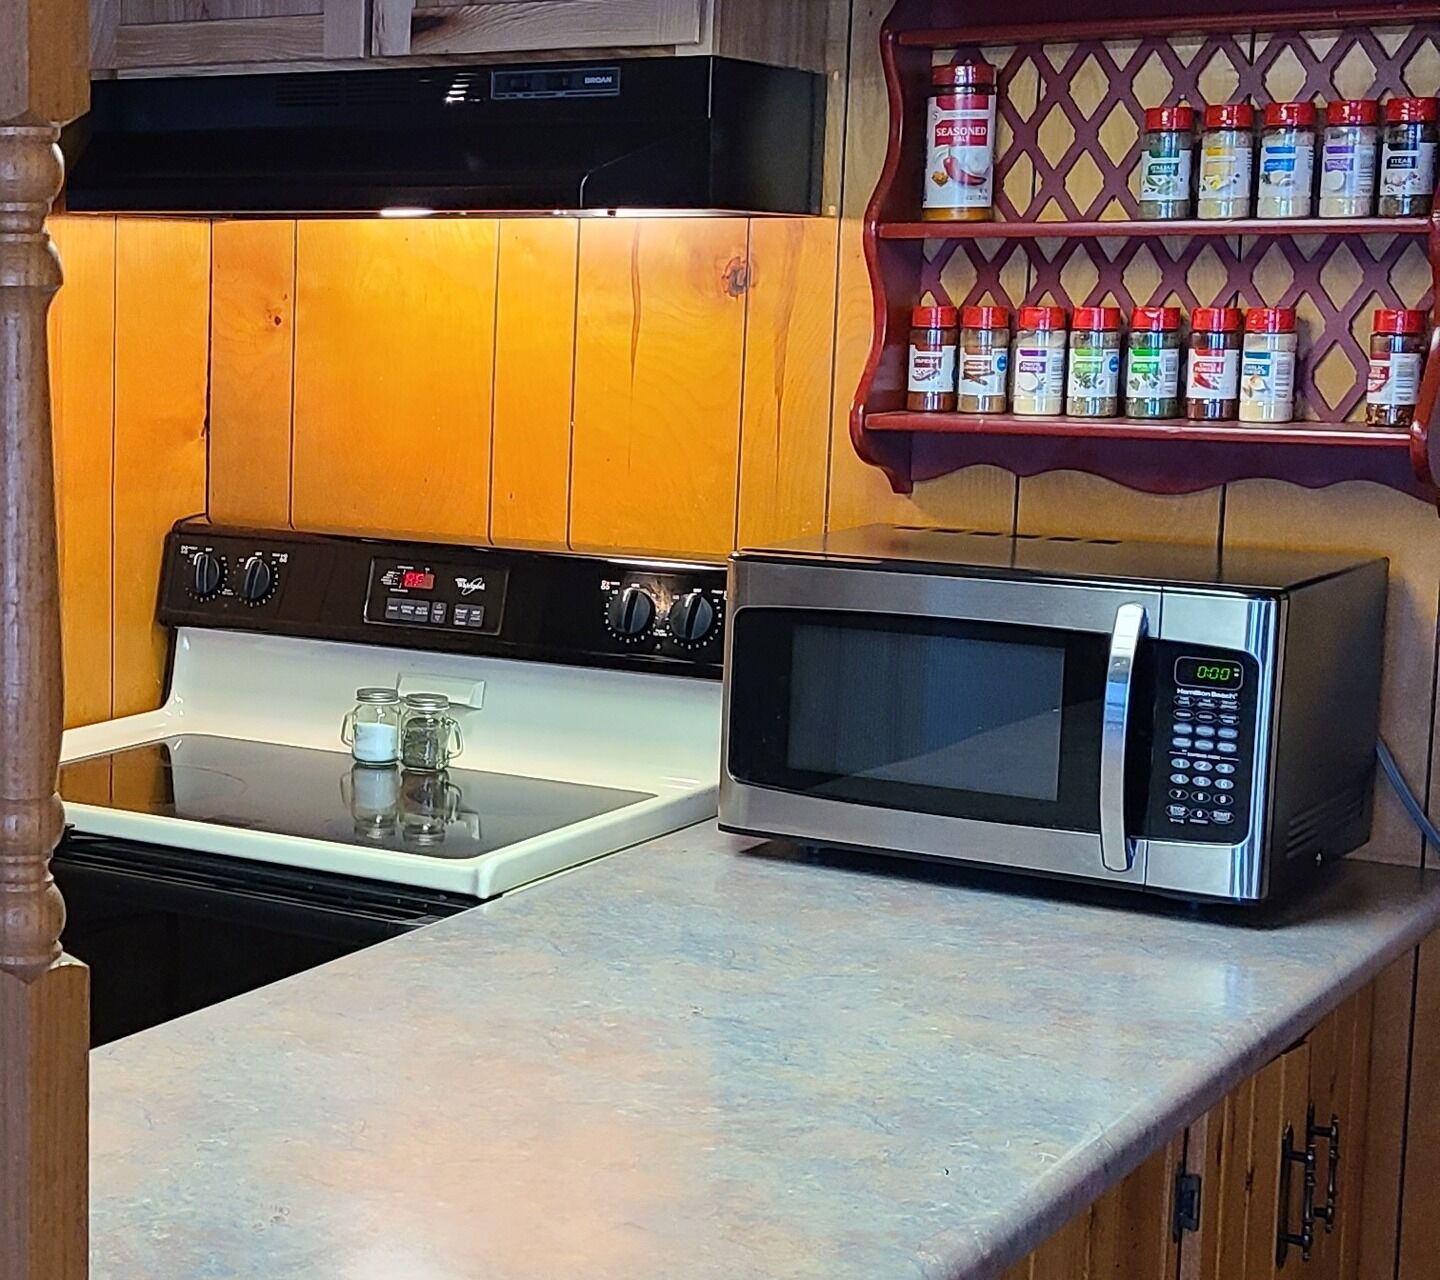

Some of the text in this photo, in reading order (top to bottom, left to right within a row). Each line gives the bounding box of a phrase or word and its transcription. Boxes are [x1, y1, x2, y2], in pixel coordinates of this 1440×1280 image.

[584, 76, 612, 84] BROAN
[935, 126, 987, 137] SEASONED
[1197, 666, 1231, 680] 0:00
[1176, 688, 1211, 697] Hamilton
[1175, 790, 1182, 798] 7
[1220, 795, 1226, 803] 9
[1196, 810, 1203, 818] 0
